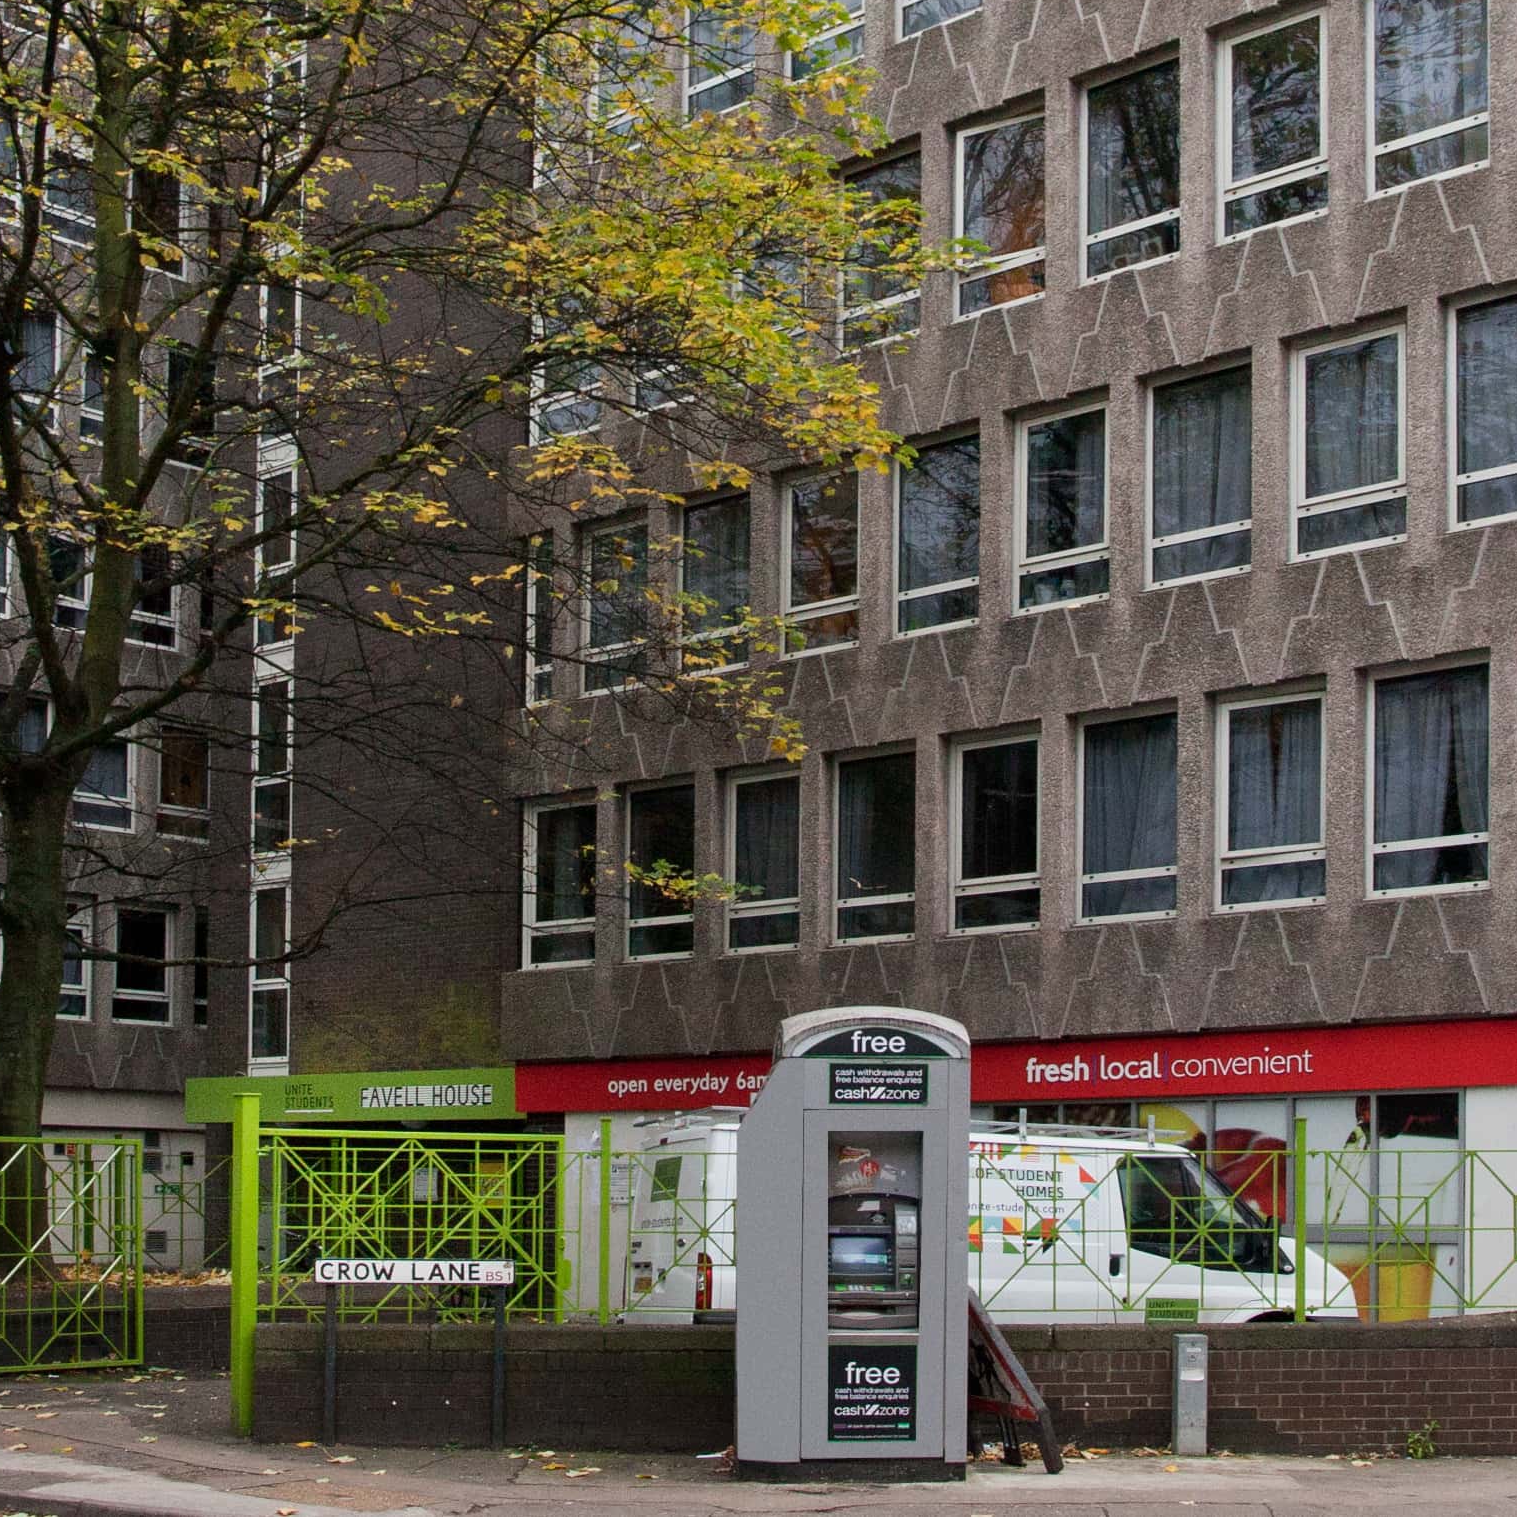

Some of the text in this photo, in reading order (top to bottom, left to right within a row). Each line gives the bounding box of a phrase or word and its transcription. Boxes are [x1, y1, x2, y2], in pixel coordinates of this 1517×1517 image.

[851, 1030, 907, 1053] free
[835, 1068, 923, 1076] cash withdrawals and
[1025, 1046, 1314, 1083] fresh local convenient
[608, 1078, 648, 1098] open
[654, 1071, 729, 1095] everyday
[835, 1076, 923, 1085] free balance enquiries
[285, 1084, 313, 1095] UNITE
[360, 1085, 492, 1107] FAVELL HOUSE
[285, 1096, 334, 1109] STUDENTS
[975, 1168, 993, 1179] OF
[1016, 1185, 1064, 1198] HOMES
[320, 1262, 396, 1281] CROW
[411, 1263, 481, 1281] LANE
[485, 1271, 503, 1282] BS
[844, 1361, 901, 1384] free
